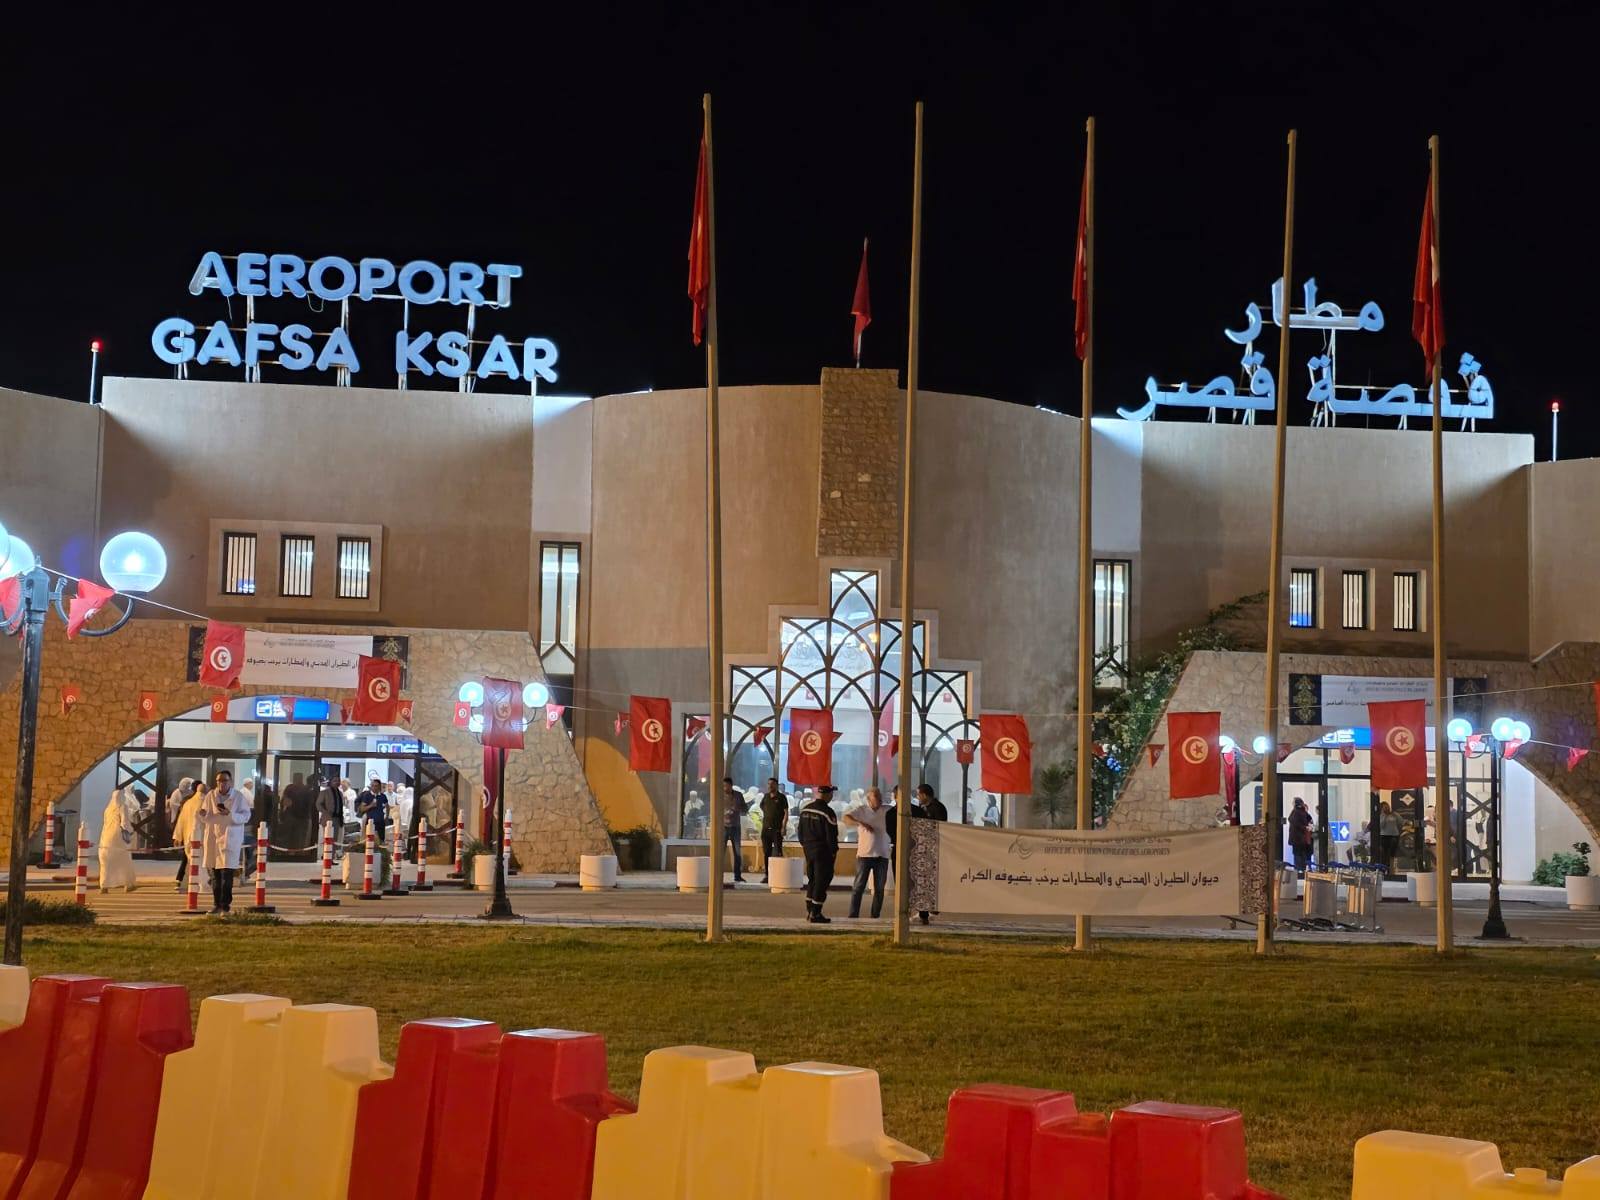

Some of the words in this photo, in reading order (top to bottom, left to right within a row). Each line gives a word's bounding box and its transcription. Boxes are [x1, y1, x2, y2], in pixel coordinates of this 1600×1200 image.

[189, 251, 523, 307] AEROPORT
[1224, 277, 1385, 344] مطار
[151, 317, 361, 373] GAFSA
[396, 329, 559, 384] KSAR
[1116, 350, 1276, 422] قصر
[960, 867, 992, 883] الكرام
[1062, 871, 1112, 887] والمطارات
[1115, 871, 1151, 888] المدني
[1154, 871, 1189, 887] الطيران
[1192, 871, 1219, 886] ديوان
